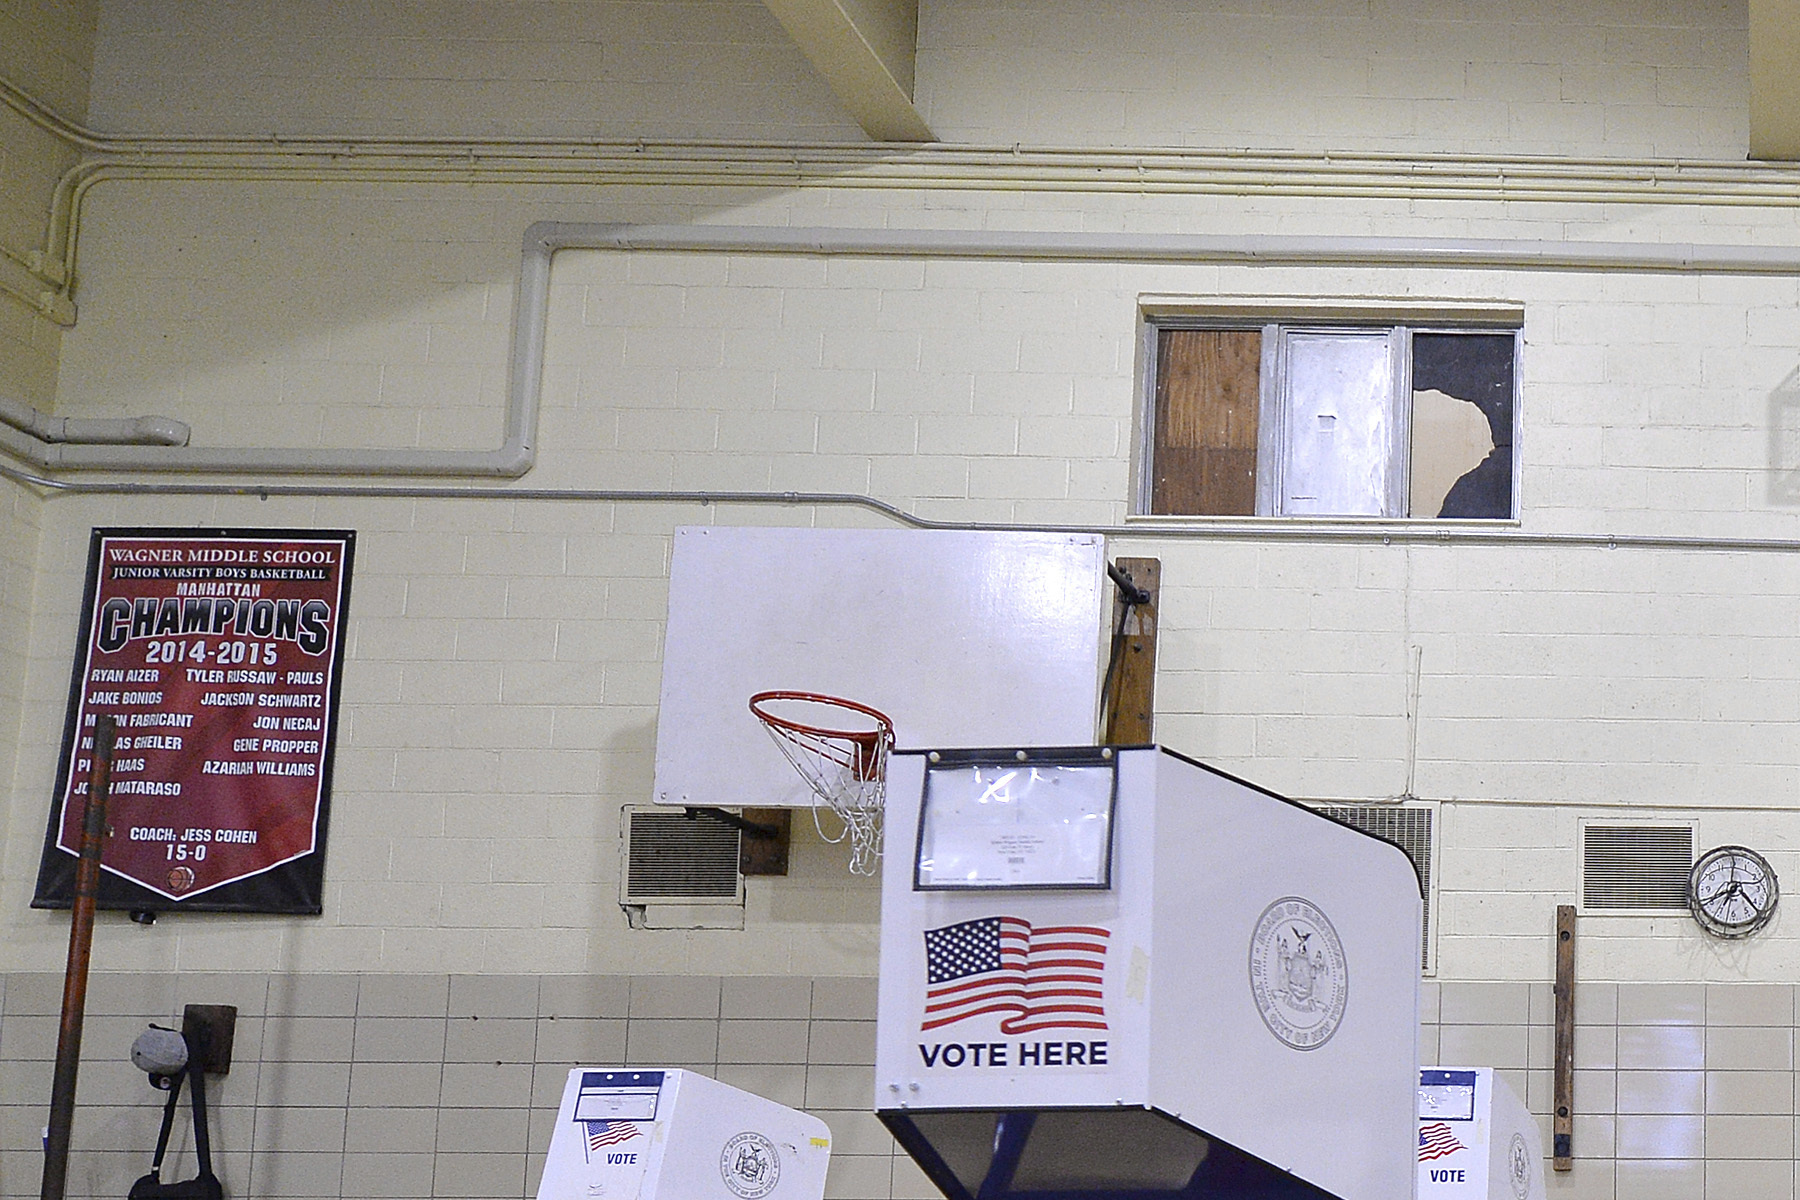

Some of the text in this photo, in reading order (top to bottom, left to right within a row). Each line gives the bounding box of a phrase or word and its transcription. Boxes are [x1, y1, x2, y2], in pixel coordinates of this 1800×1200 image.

[109, 548, 335, 564] WAGNER MIDDLE SCHOOL
[112, 567, 326, 580] JUNIOR VARSITY BOYS BASKETBALL
[176, 582, 261, 597] MANHATTAN
[97, 597, 331, 657] CHAMPIONS
[146, 640, 277, 665] 2014-2015
[91, 669, 160, 682] RYAN AIZER
[185, 669, 324, 685] TYLER RUSSAW PAULS
[88, 692, 163, 705] JAKE BONIOS
[200, 692, 322, 708] JACKSON SCHWARTZ
[130, 713, 194, 728] FABRICANT
[252, 716, 321, 731] JON NECAJ
[133, 736, 183, 750] GHEILER
[233, 738, 319, 754] GENE PROPPER
[116, 758, 145, 772] HAAS
[202, 760, 316, 776] AZARIAH WILLIAMS
[115, 781, 182, 796] MATARASO
[130, 826, 258, 844] COACH: JESS COHEN
[166, 844, 207, 861] 15-0
[918, 1041, 1108, 1068] VOTE HERE
[606, 1153, 638, 1166] VOTE
[1430, 1169, 1466, 1183] VOTE
